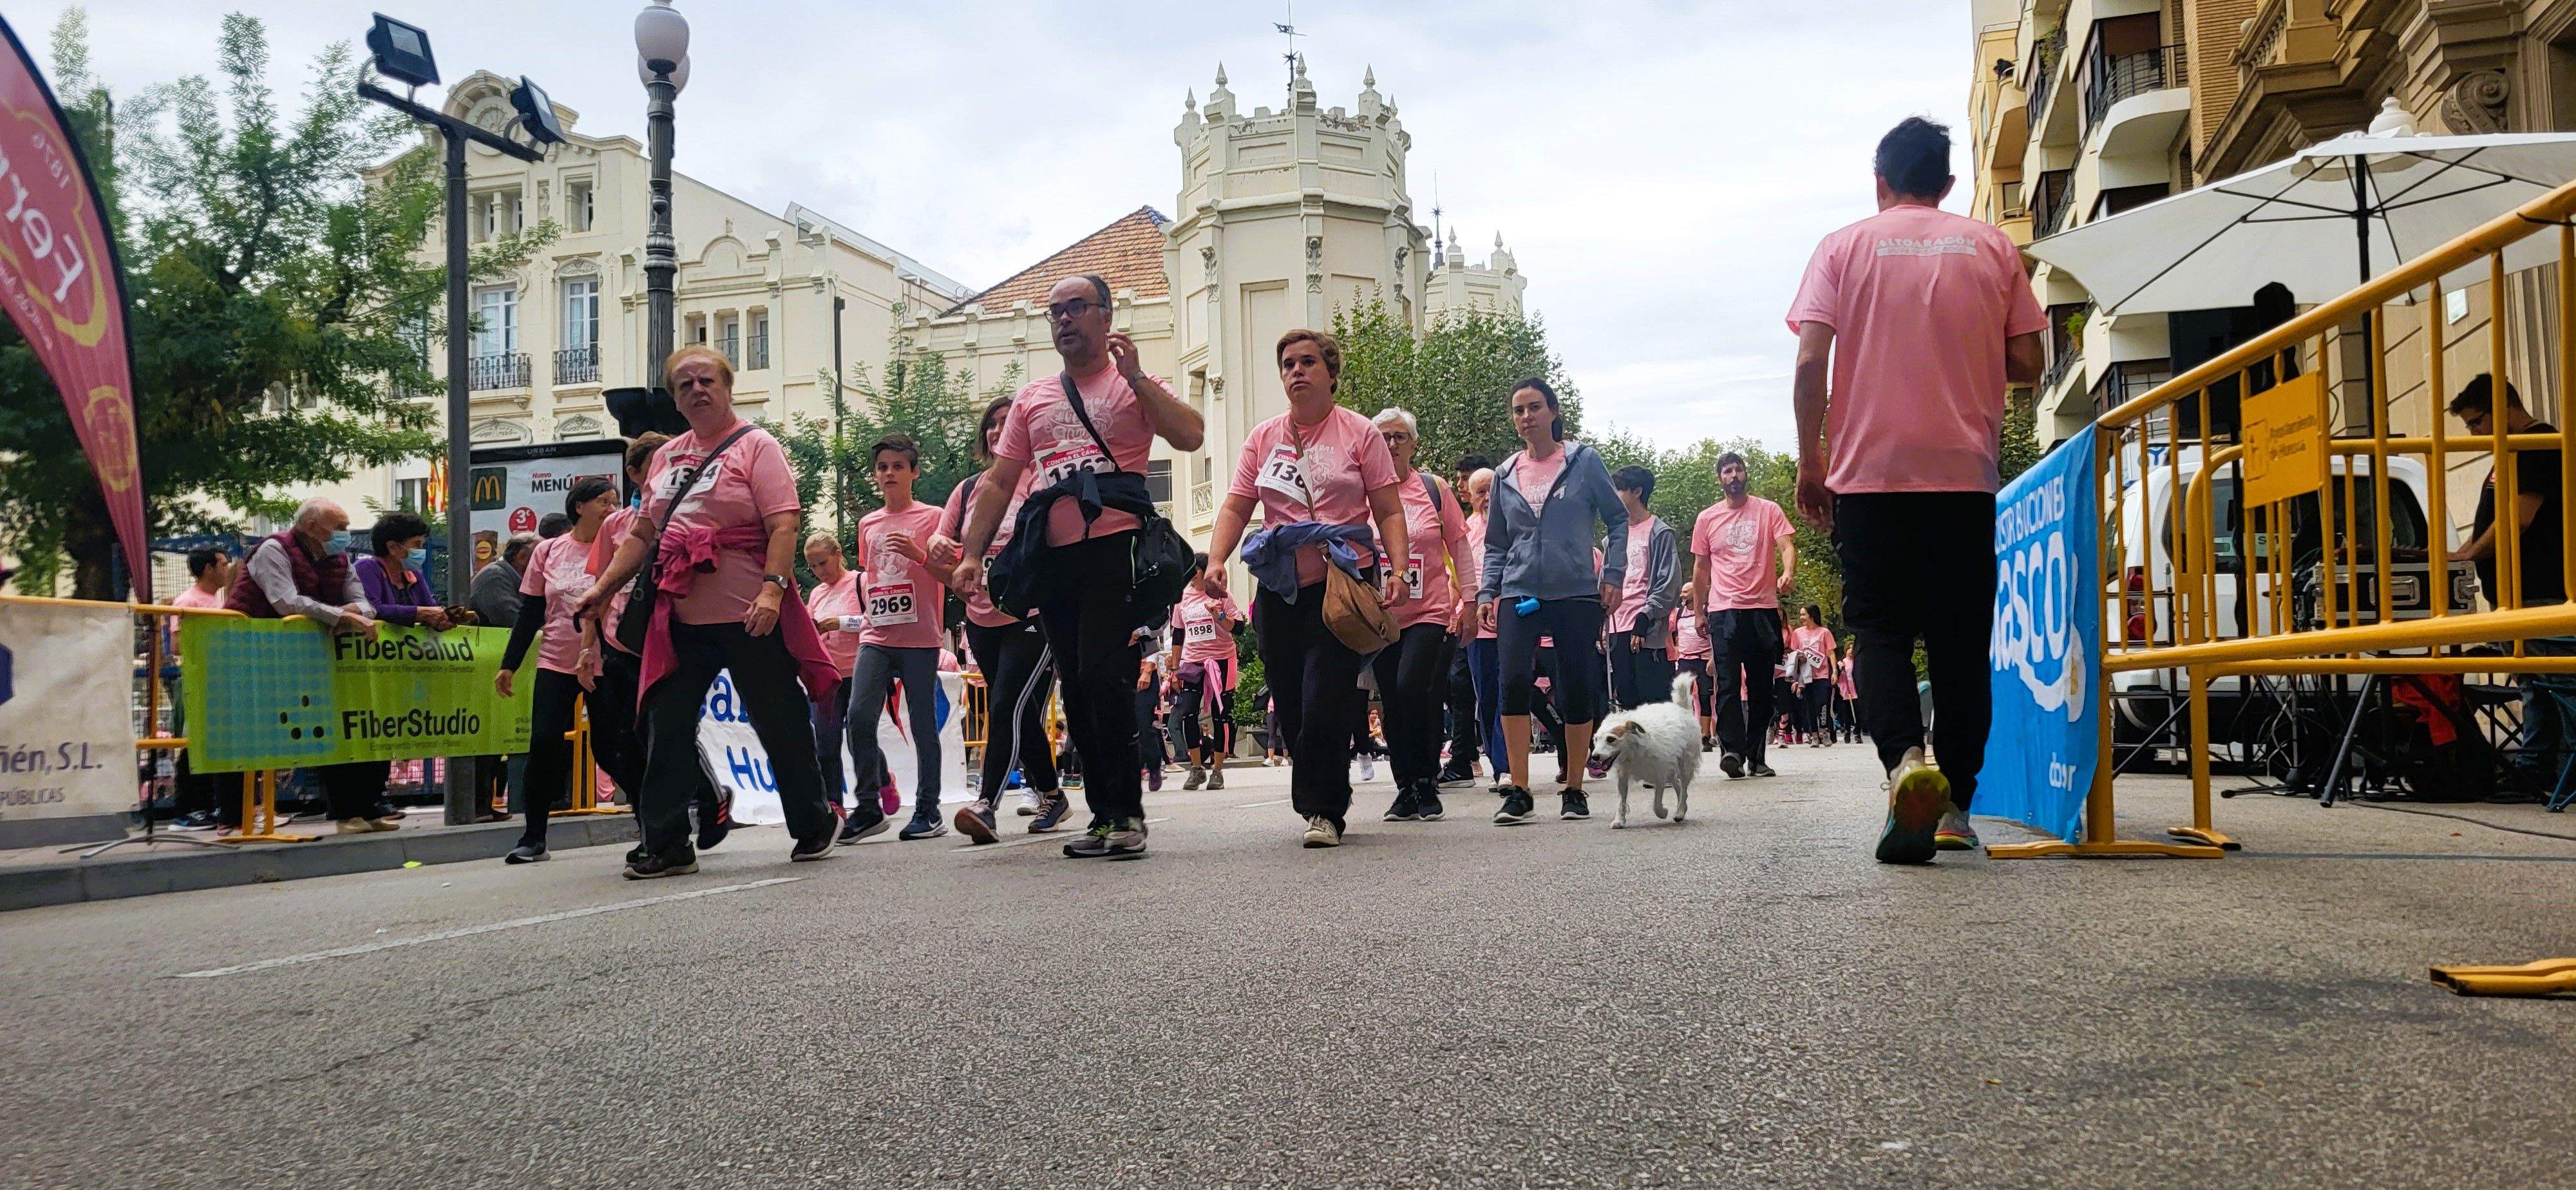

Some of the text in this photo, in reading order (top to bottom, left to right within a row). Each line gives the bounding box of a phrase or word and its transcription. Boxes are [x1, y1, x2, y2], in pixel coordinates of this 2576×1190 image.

[531, 473, 573, 493] MENÚ
[871, 595, 913, 616] 2969
[1989, 531, 2067, 672] asco
[1188, 624, 1213, 636] 1898
[334, 631, 474, 662] FiberSalud
[342, 708, 480, 739] FiberStudio
